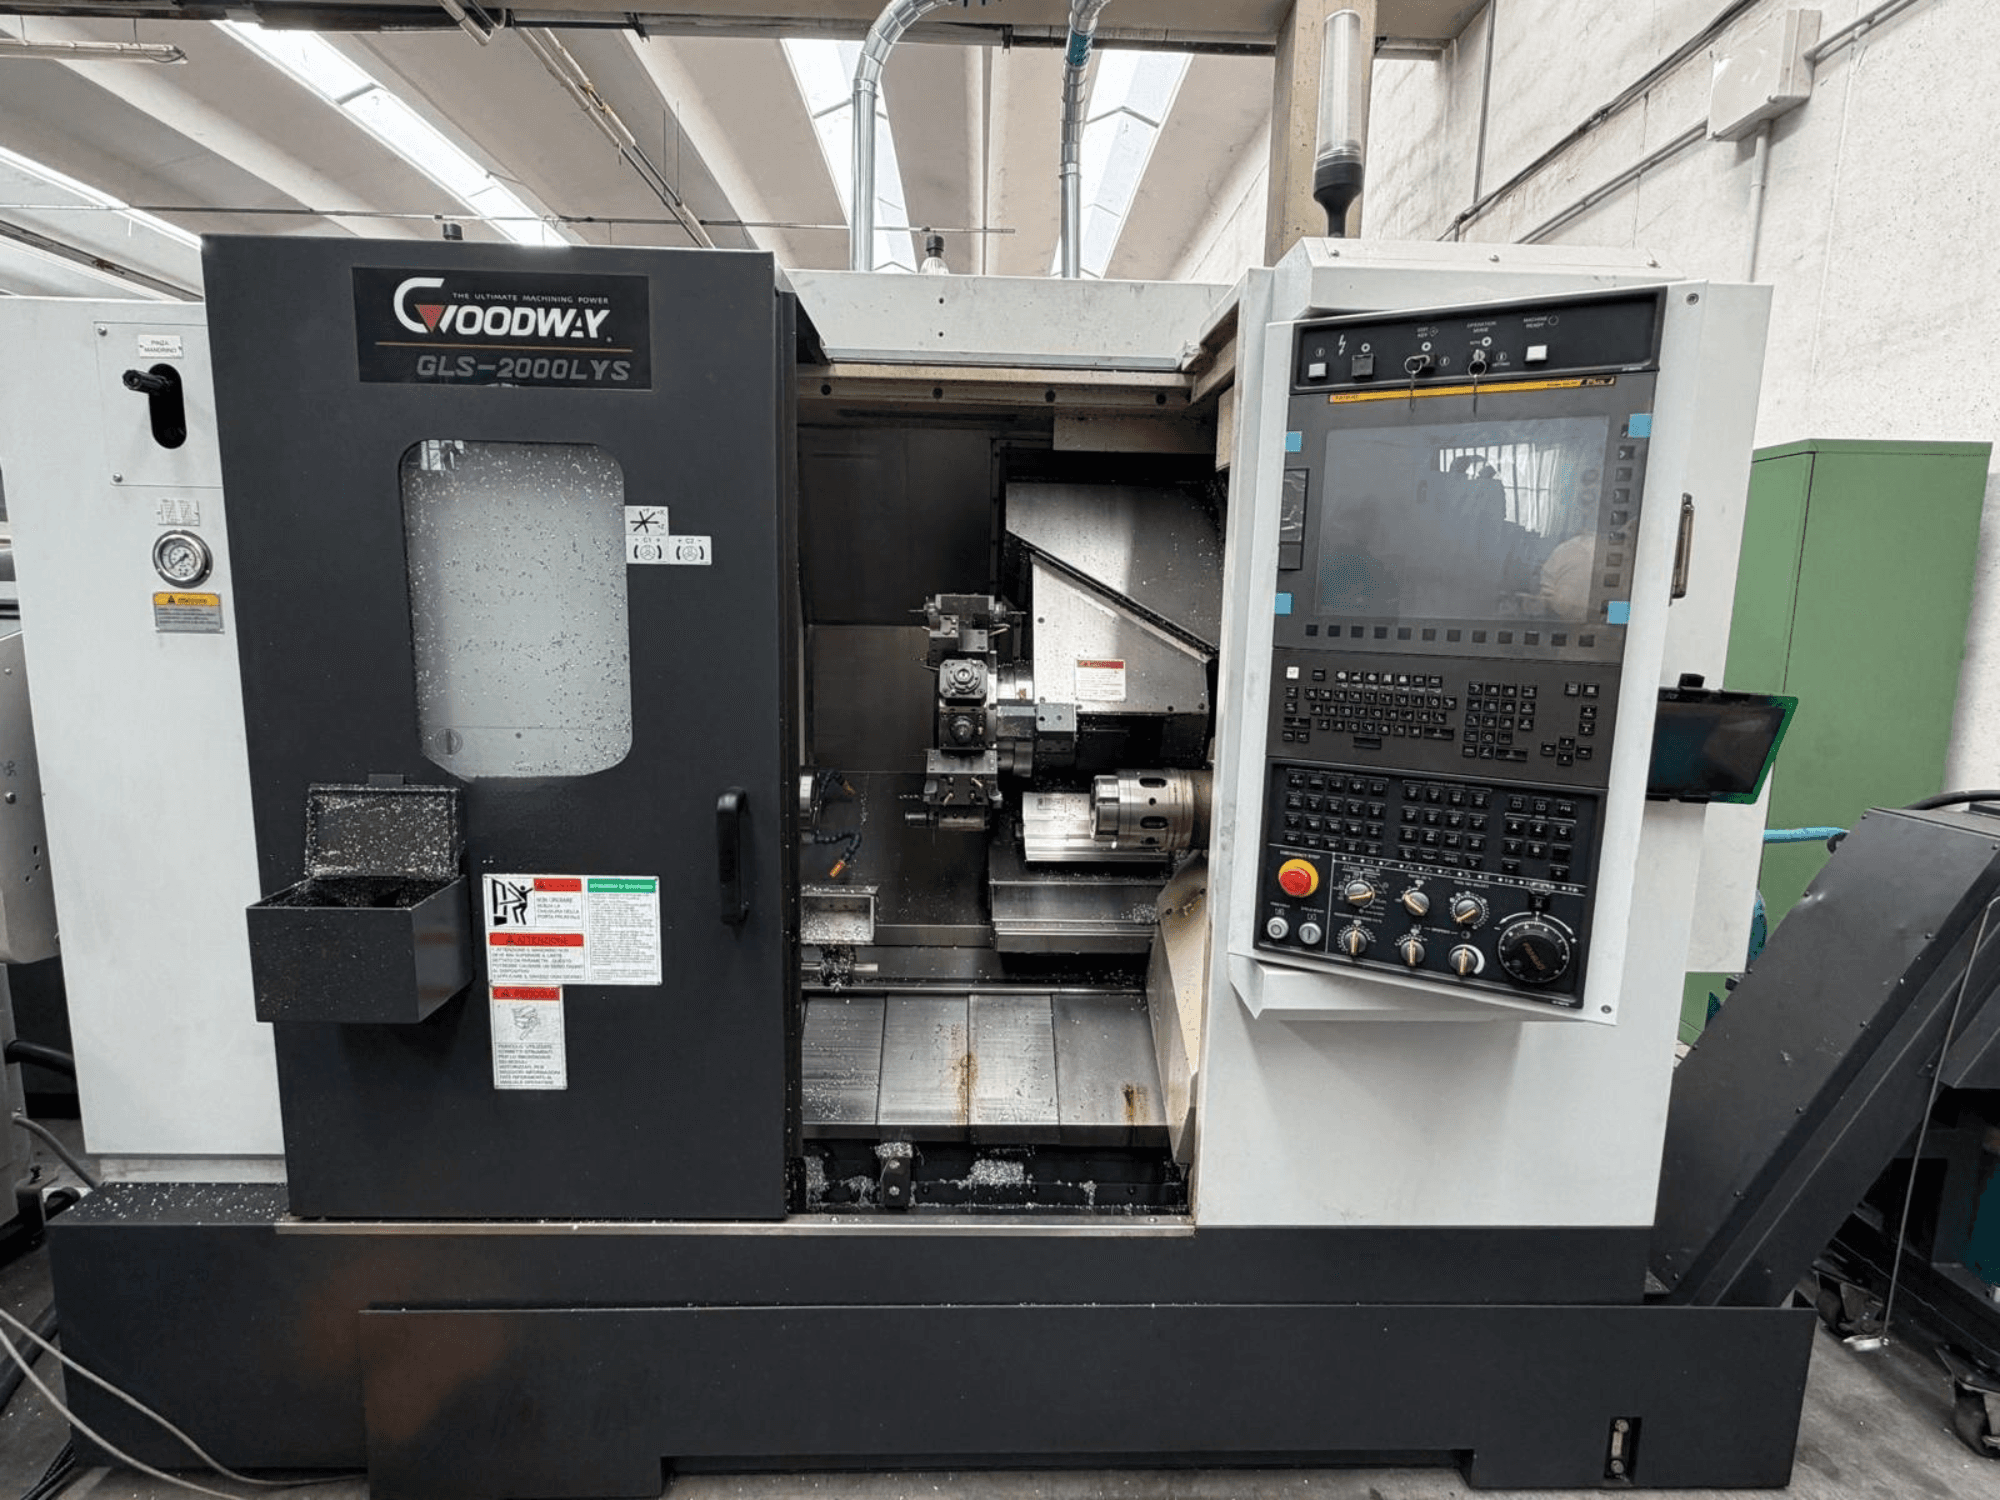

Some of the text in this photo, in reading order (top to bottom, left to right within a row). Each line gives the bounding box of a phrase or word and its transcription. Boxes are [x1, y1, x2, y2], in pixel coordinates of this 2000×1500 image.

[393, 276, 611, 339] GOODWAY
[451, 292, 609, 304] THE ULTIMATE MACHINING POWER
[416, 355, 631, 381] GLS-2000LYS
